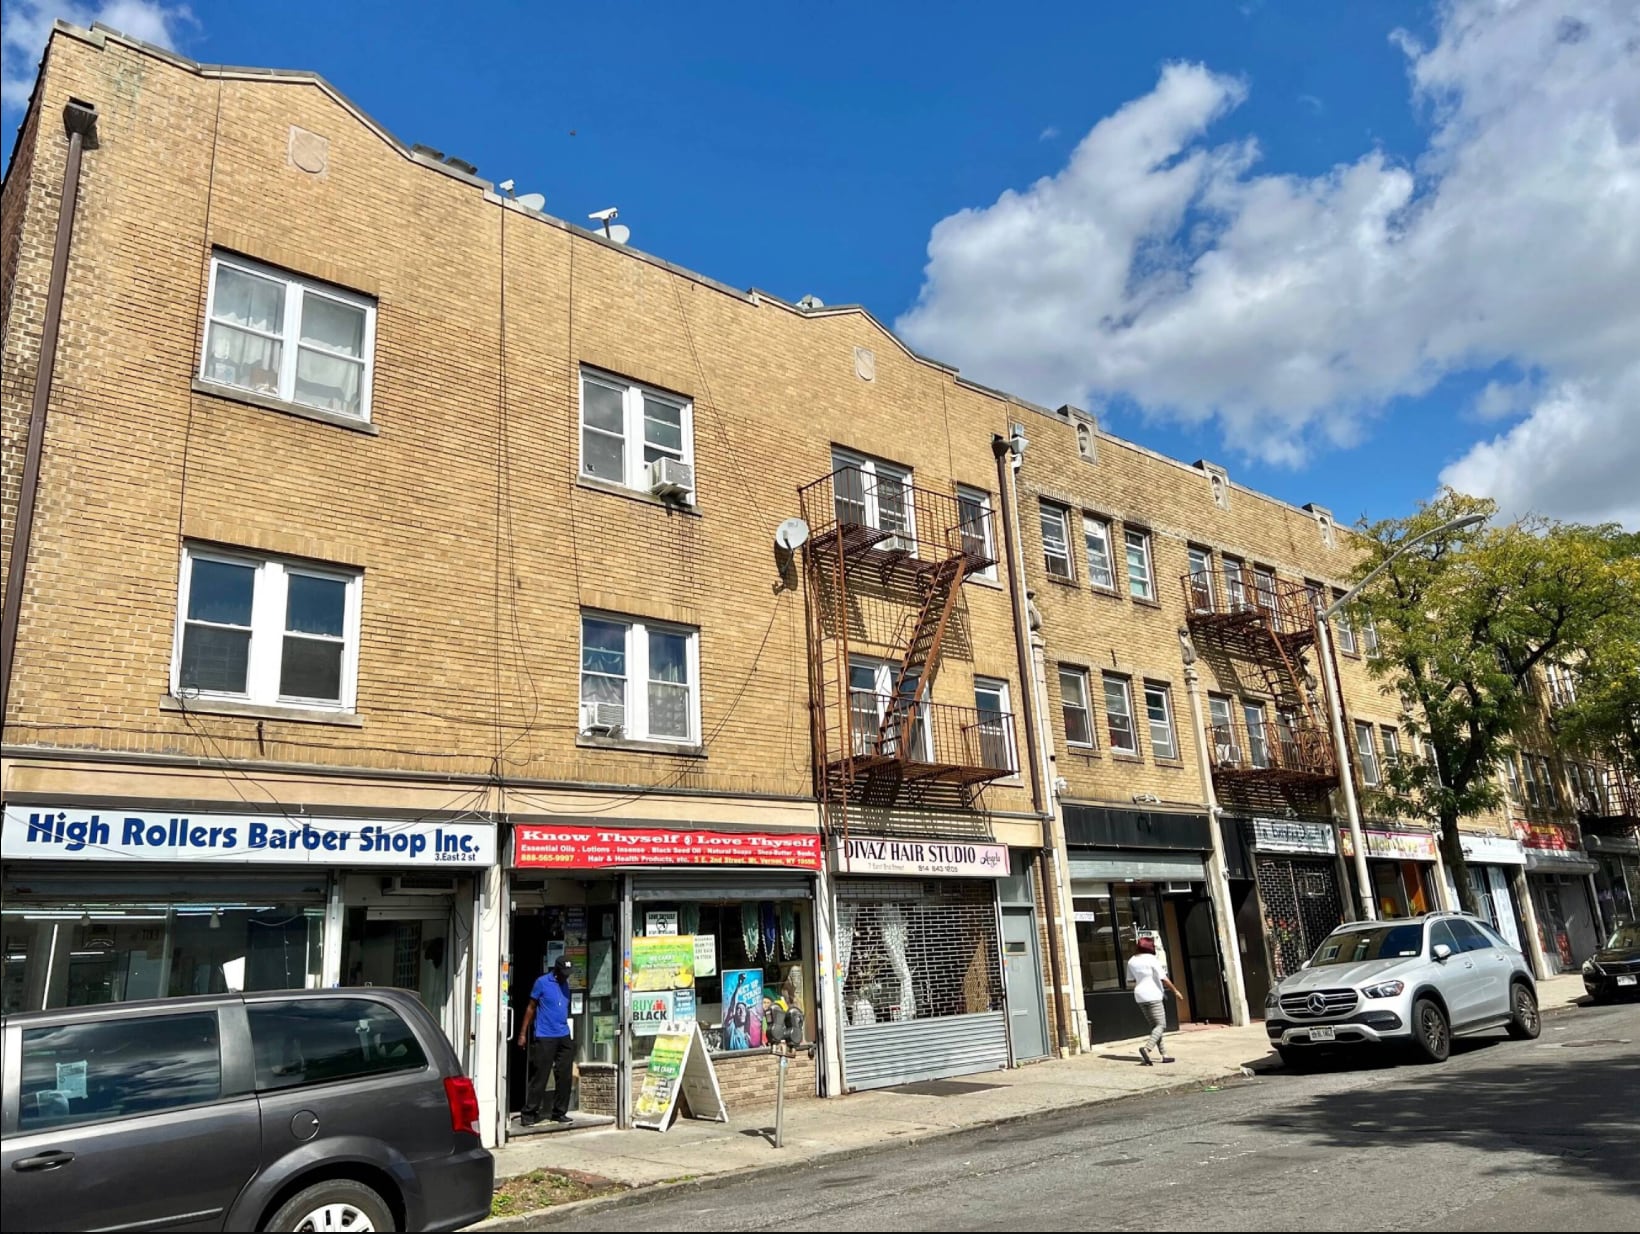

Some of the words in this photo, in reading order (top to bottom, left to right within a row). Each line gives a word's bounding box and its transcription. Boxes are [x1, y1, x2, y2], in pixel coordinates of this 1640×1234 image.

[26, 812, 110, 851] High
[121, 817, 237, 849] Rollers
[248, 822, 352, 851] Barber
[359, 826, 426, 858] Shop
[435, 828, 480, 853] Inc.
[521, 830, 591, 842] Know
[597, 832, 681, 845] Thyself
[697, 835, 742, 846] Love
[748, 837, 816, 848] Thyself
[521, 844, 559, 852] Essential
[560, 845, 576, 853] Oils
[581, 845, 610, 853] Lotions
[652, 846, 672, 854] Black
[844, 840, 886, 860] DIVAZ
[890, 843, 924, 862] HAIR
[928, 845, 976, 864] STUDIO
[461, 853, 467, 861] 2
[468, 853, 476, 861] st
[641, 856, 674, 864] Products,
[632, 1000, 653, 1010] BUY
[632, 1011, 667, 1021] BLACK
